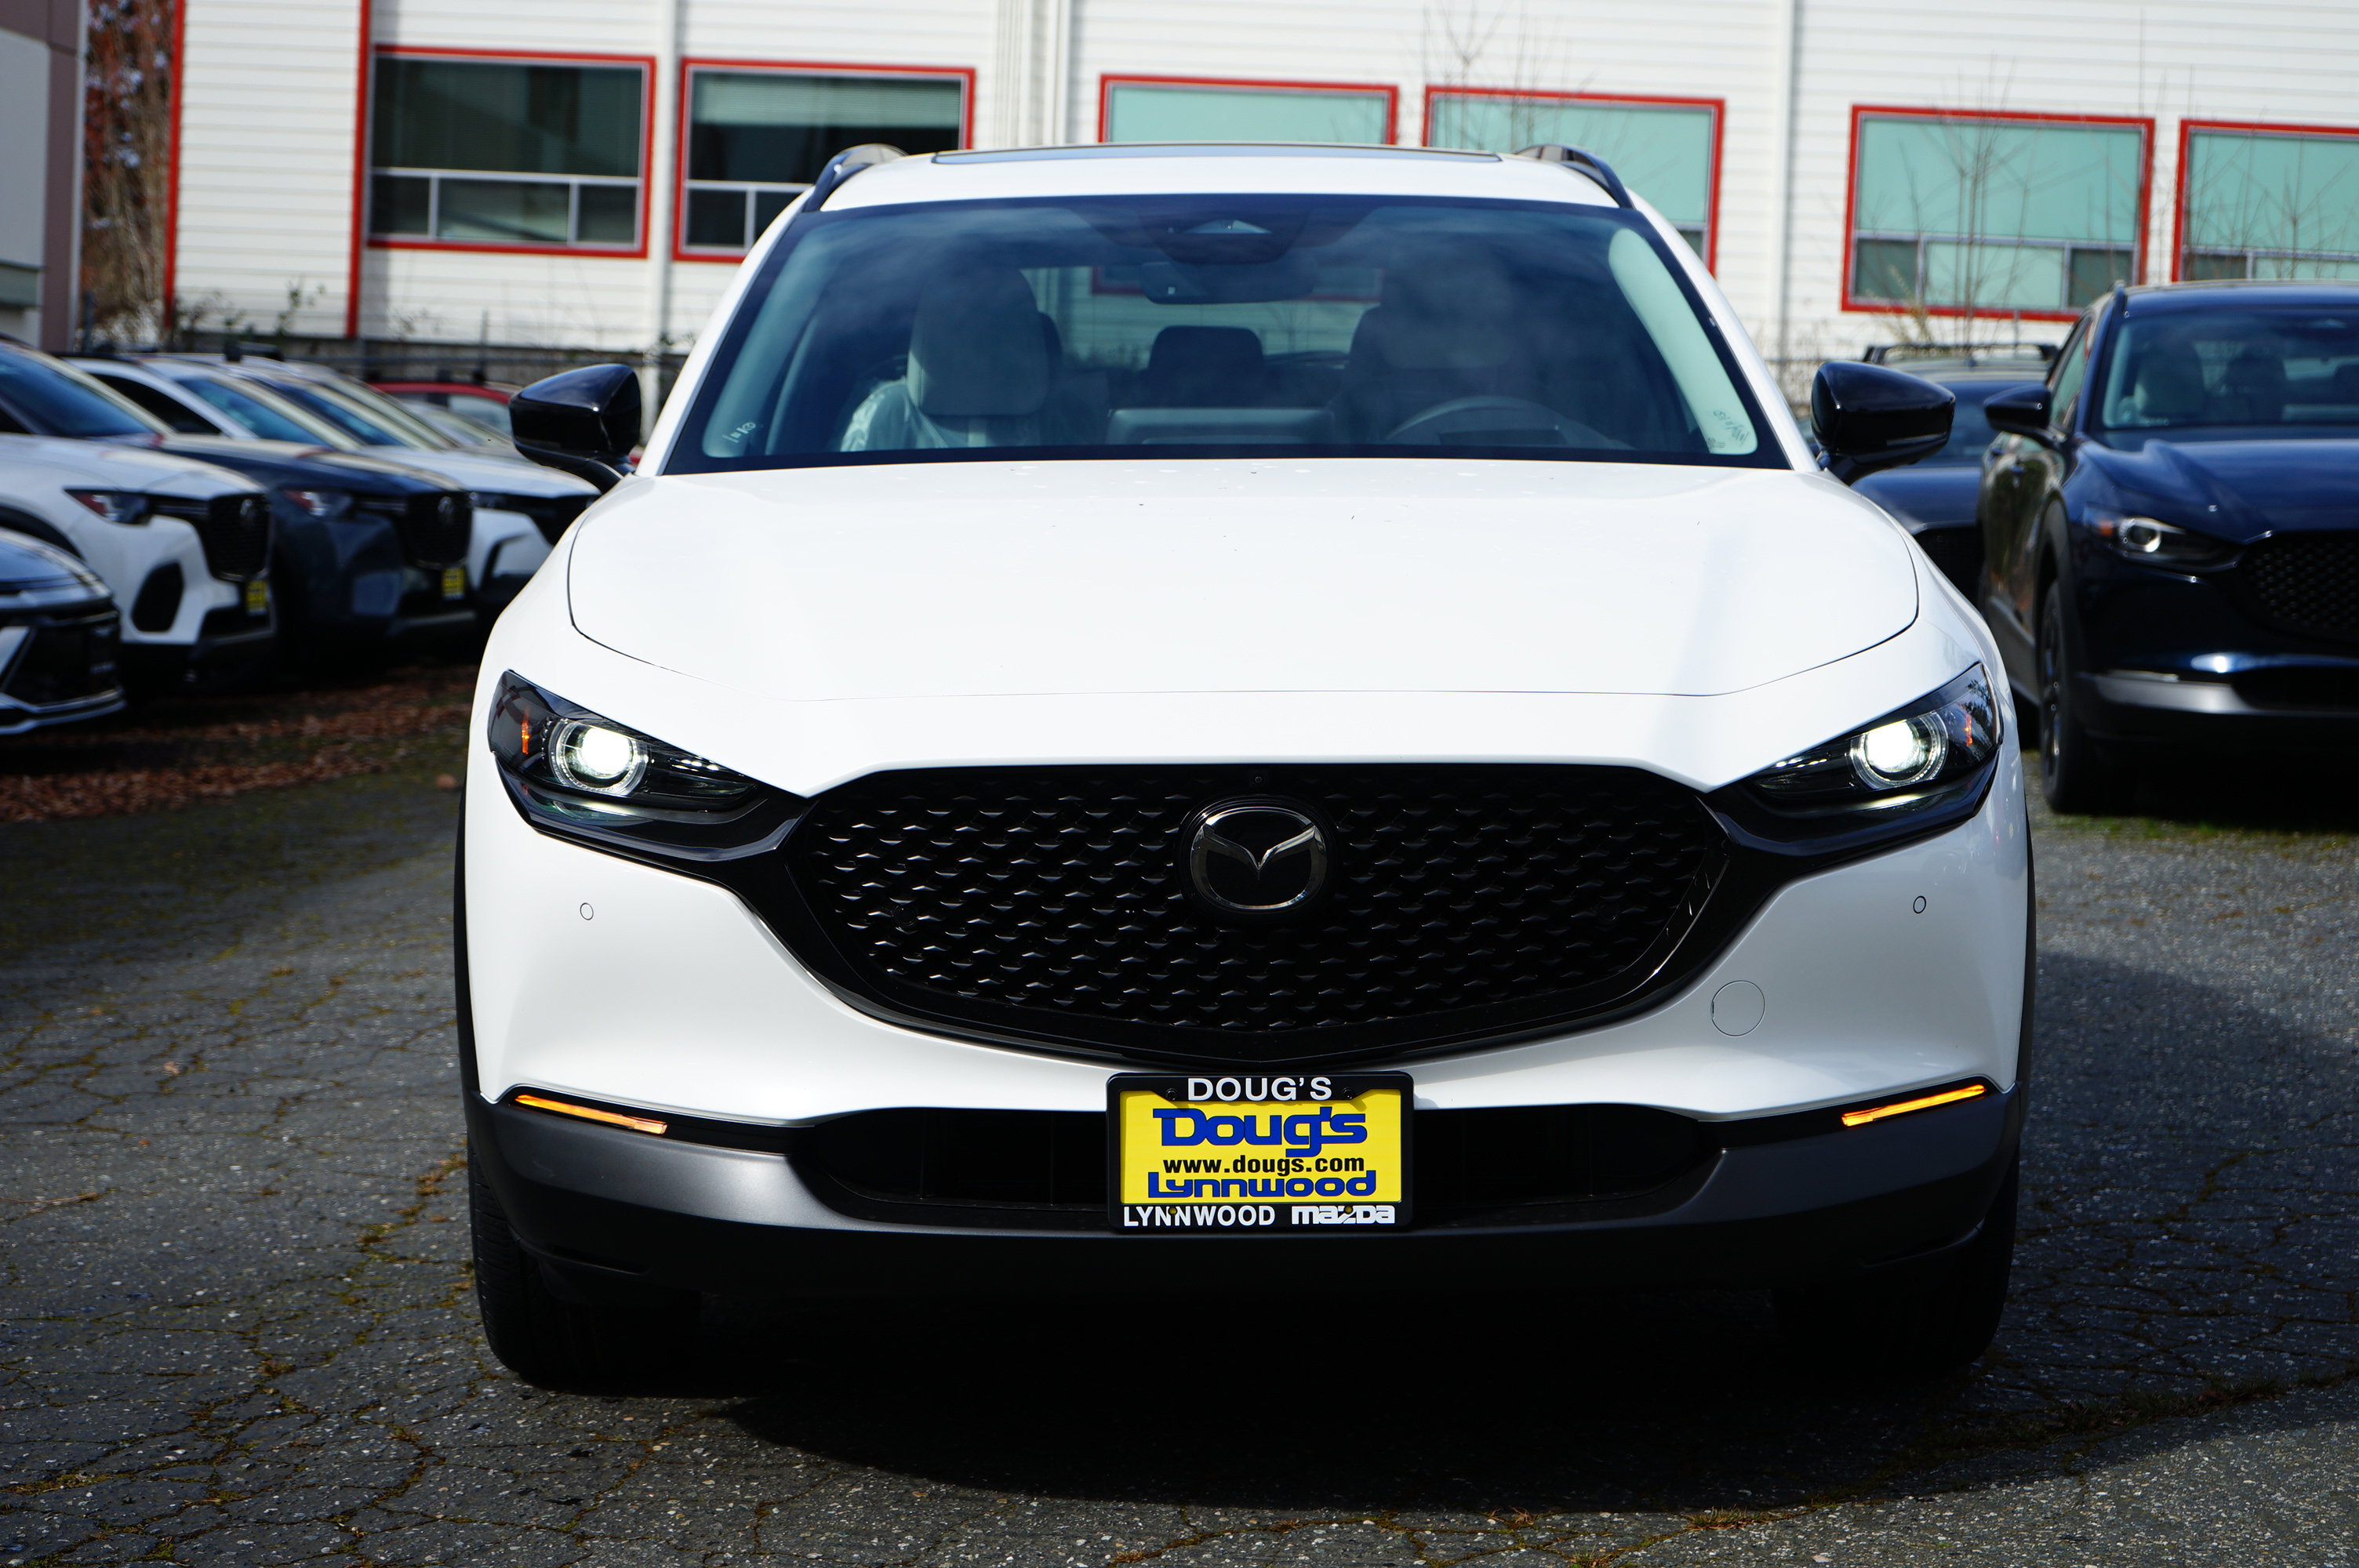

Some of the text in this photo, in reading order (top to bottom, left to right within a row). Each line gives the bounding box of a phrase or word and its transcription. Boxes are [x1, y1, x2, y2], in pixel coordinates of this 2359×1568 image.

[1188, 1077, 1332, 1102] DOUG'S
[1153, 1106, 1368, 1158] Doug's
[1163, 1155, 1365, 1176] www.dougs.com
[1148, 1171, 1376, 1198] Lynnwood
[1124, 1206, 1275, 1226] LYNNWOOD
